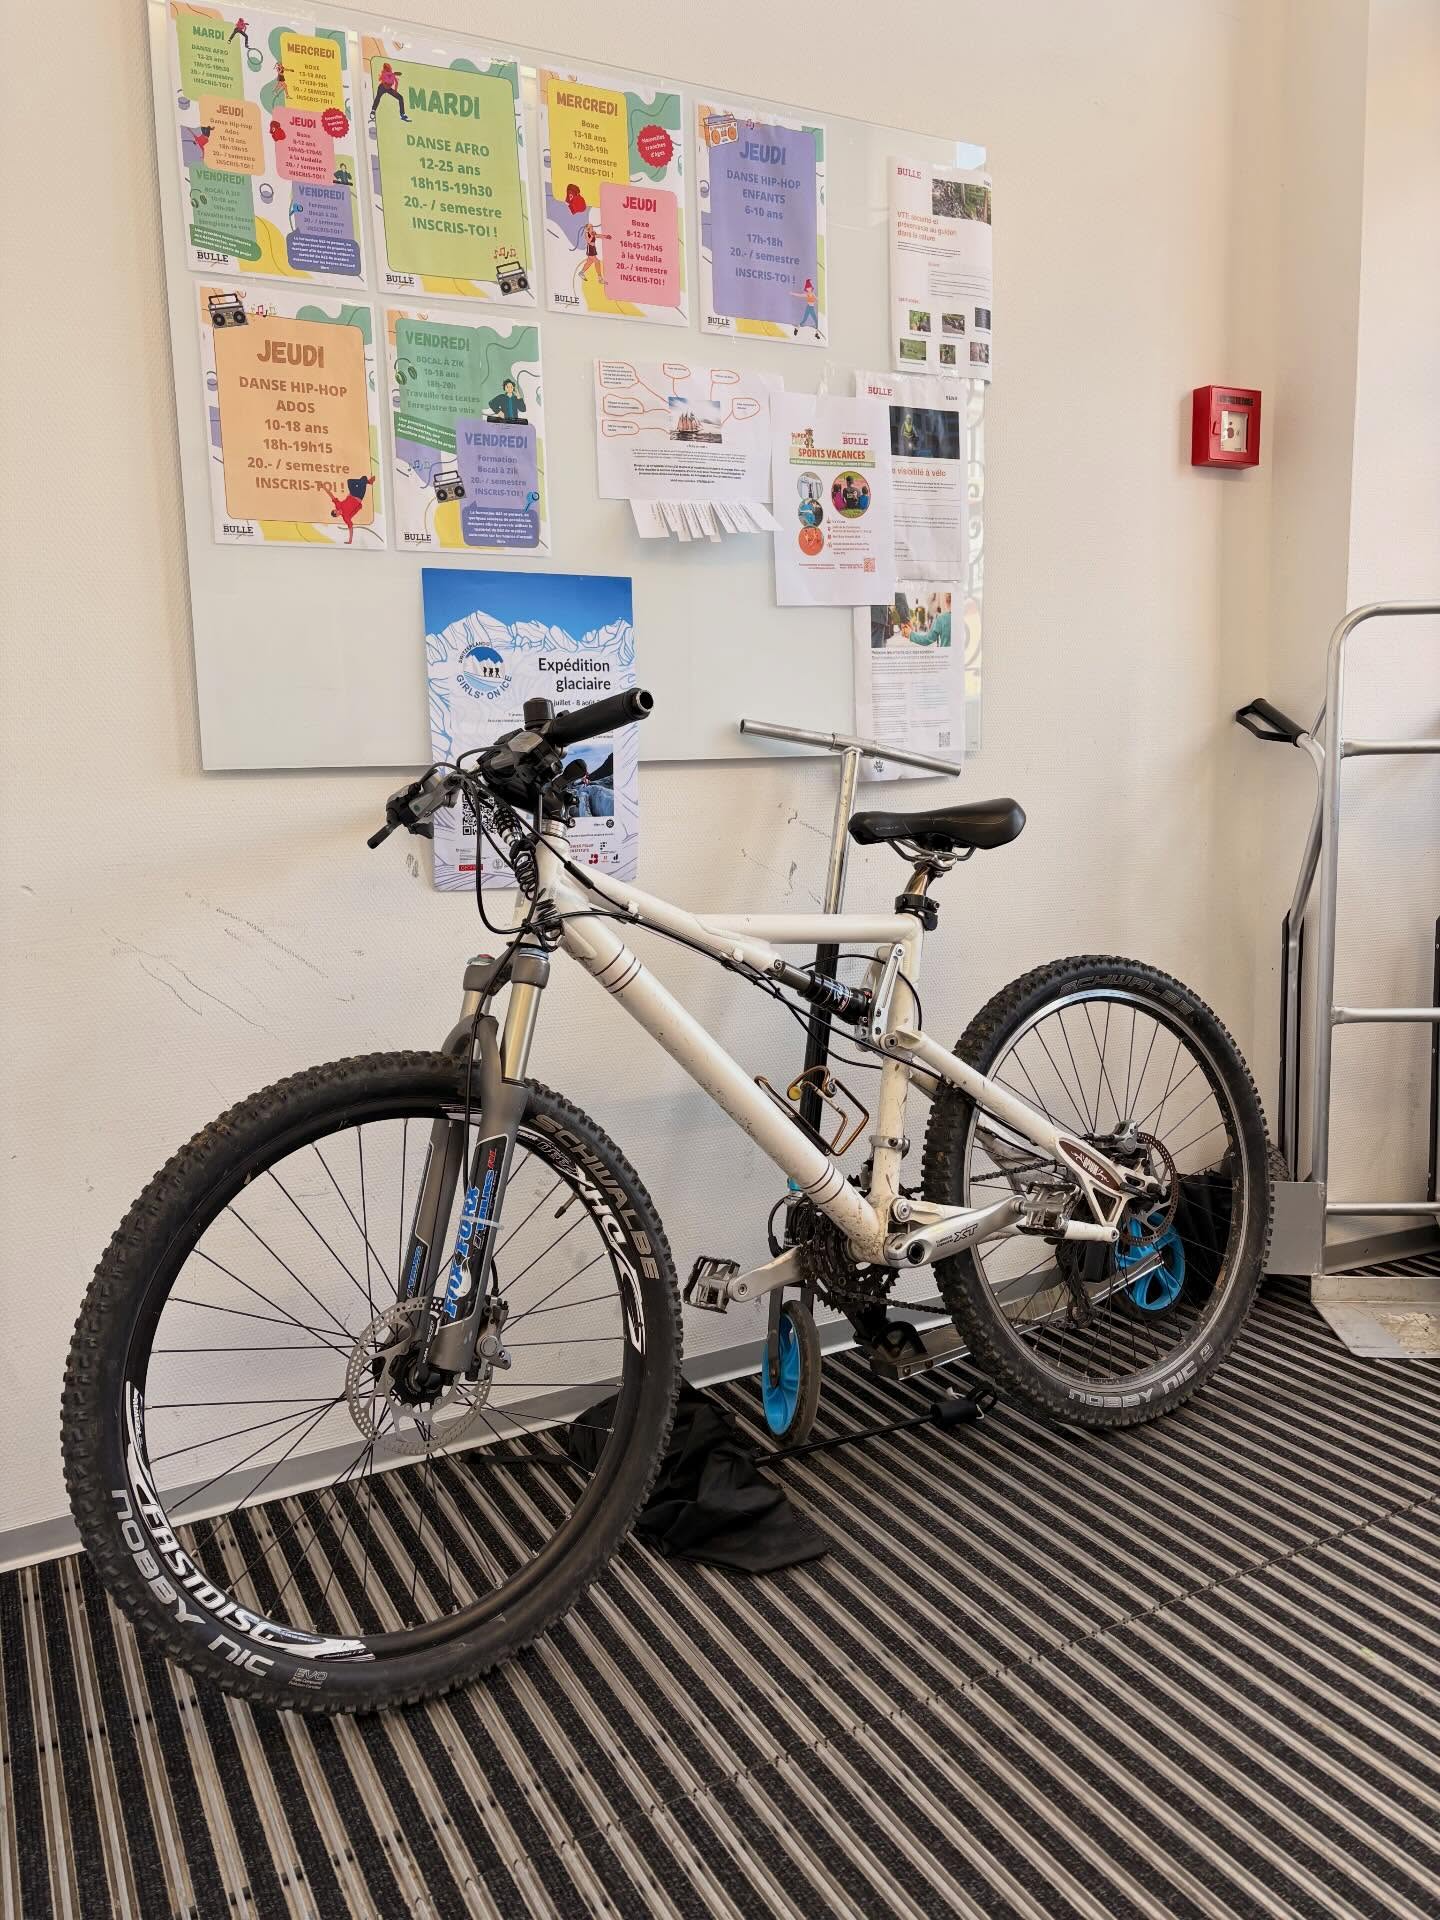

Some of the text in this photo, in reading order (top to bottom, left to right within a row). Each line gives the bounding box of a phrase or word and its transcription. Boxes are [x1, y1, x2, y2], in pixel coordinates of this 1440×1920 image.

[192, 25, 224, 40] MARDI
[287, 43, 335, 59] MERCREDI
[408, 86, 480, 119] MARDI
[557, 92, 618, 116] MERCREDI
[216, 104, 244, 117] JEUDI
[289, 116, 316, 129] JEUDI
[581, 119, 600, 130] Boxe
[573, 130, 607, 143] 13-18 ans
[406, 134, 490, 157] DANSE AFRO
[573, 142, 609, 155] 17h30-19h
[740, 141, 786, 165] JEUDI
[419, 157, 481, 176] 12-25 ans
[564, 151, 578, 159] 30.-
[583, 156, 618, 168] semestre
[195, 169, 245, 185] VENDREDI
[567, 163, 610, 177] INSCRIS-TOI
[897, 167, 921, 179] BULLE
[727, 169, 801, 189] DANSE HIP-HOP
[299, 185, 345, 200] VENDREDI
[410, 176, 493, 198] 18h15-19h30
[622, 196, 657, 213] JEUDI
[743, 191, 786, 204] ENFANTS
[404, 195, 428, 209] 20.-
[440, 201, 502, 219] semestre
[745, 206, 784, 220] 6-10 ans
[412, 217, 490, 237] INSCRIS-TOI
[632, 219, 650, 228] Boxe
[627, 230, 641, 239] 8-12
[747, 233, 783, 248] 17h-18h
[620, 241, 663, 253] 16h45-17h45
[197, 251, 229, 262] BULLE
[636, 254, 663, 263] Vudalla
[730, 247, 748, 257] 20.-
[755, 251, 800, 265] semestre
[616, 262, 630, 270] 20.-
[635, 266, 668, 275] semestre
[735, 267, 791, 283] INSCRIS-TOI
[386, 274, 415, 285] BULLE
[620, 274, 662, 286] INSCRIS-TOI
[554, 294, 580, 304] BULLE
[707, 316, 730, 326] BULLE
[405, 330, 470, 352] VENDREDI
[257, 339, 325, 368] JEUDI
[239, 376, 347, 398] DANSE HIP-HOP
[868, 386, 893, 397] BULLE
[276, 400, 316, 414] ADOS
[264, 419, 329, 435] 10-18 ans
[264, 438, 333, 455] 18h-19h15
[465, 432, 528, 449] VENDREDI
[842, 437, 869, 446] BULLE
[477, 454, 517, 464] Formation
[798, 448, 866, 460] SPORTS VACANCES
[247, 457, 273, 469] 20.-
[286, 461, 350, 475] semestre
[477, 465, 500, 474] Bocal
[506, 467, 518, 475] Zik
[255, 476, 339, 493] INSCRIS-TOI
[475, 487, 520, 497] INSCRIS-TOI
[223, 525, 254, 535] BULLE
[404, 533, 431, 542] BULLE
[538, 657, 610, 674] Expédition
[487, 689, 501, 700] ON
[500, 675, 513, 691] ICE
[556, 676, 611, 693] glaciaire
[553, 699, 571, 707] juillet
[530, 1114, 660, 1280] SCHWALBE
[953, 1222, 978, 1243] XT
[443, 1259, 462, 1319] FOX
[292, 1667, 328, 1681] EVO
